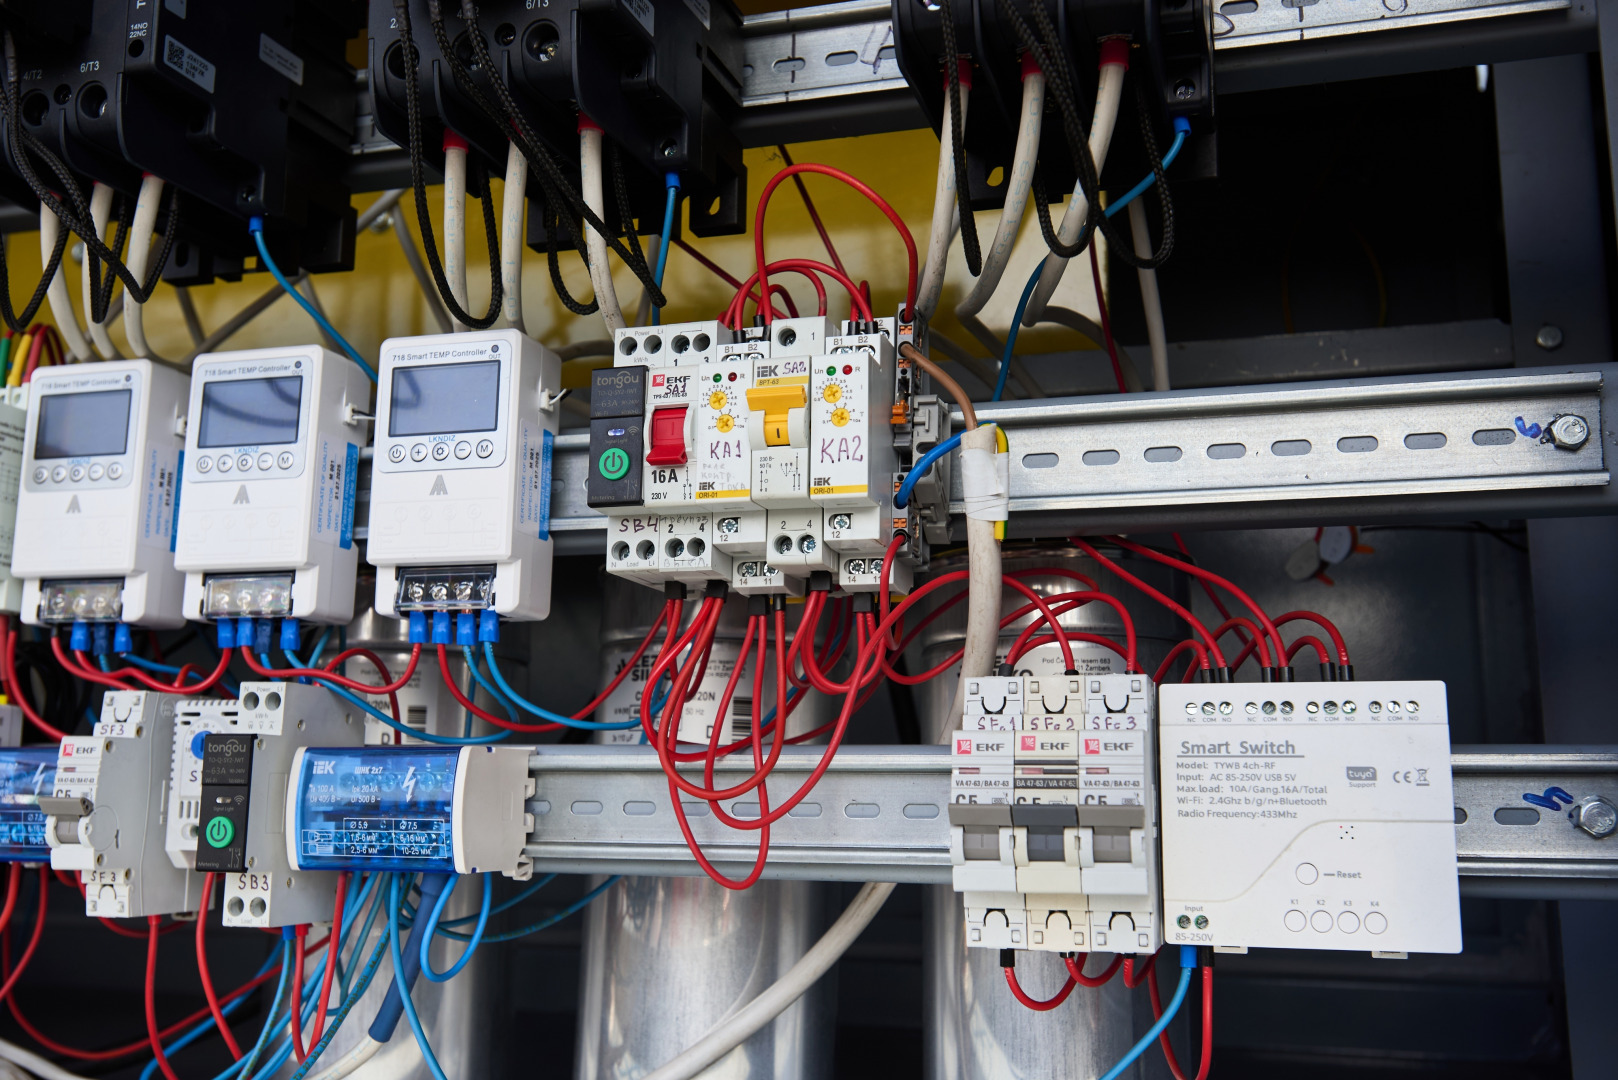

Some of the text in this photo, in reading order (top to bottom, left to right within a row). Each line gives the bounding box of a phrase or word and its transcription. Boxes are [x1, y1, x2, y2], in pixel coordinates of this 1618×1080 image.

[131, 22, 148, 30] 14NO
[129, 30, 146, 38] 22NC
[80, 60, 100, 72] 6/T3
[812, 332, 815, 340] 1
[452, 349, 487, 357] Controller
[783, 362, 806, 374] SA2
[597, 372, 639, 388] tongou
[666, 376, 690, 384] EKF
[665, 382, 686, 394] SA1
[821, 434, 864, 463] KA2
[522, 462, 526, 472] OF
[321, 474, 325, 484] OF
[651, 468, 678, 484] 16 A
[619, 516, 658, 533] SB4
[668, 523, 704, 533] 2 4
[781, 520, 812, 529] 2 4
[100, 724, 124, 735] SF3
[208, 740, 246, 756] tongou
[1104, 742, 1134, 750] EKF
[1181, 740, 1295, 754] Smart Switch
[1177, 774, 1204, 782] Input:
[1349, 770, 1372, 780] tuya
[1230, 785, 1328, 795] 10A/Gang.16A/Total
[1244, 797, 1327, 806] b/g/n+Bluetooth
[408, 821, 417, 830] 7,5
[91, 870, 116, 882] SF3
[238, 873, 269, 891] SB3
[1175, 933, 1214, 942] 85-250V
